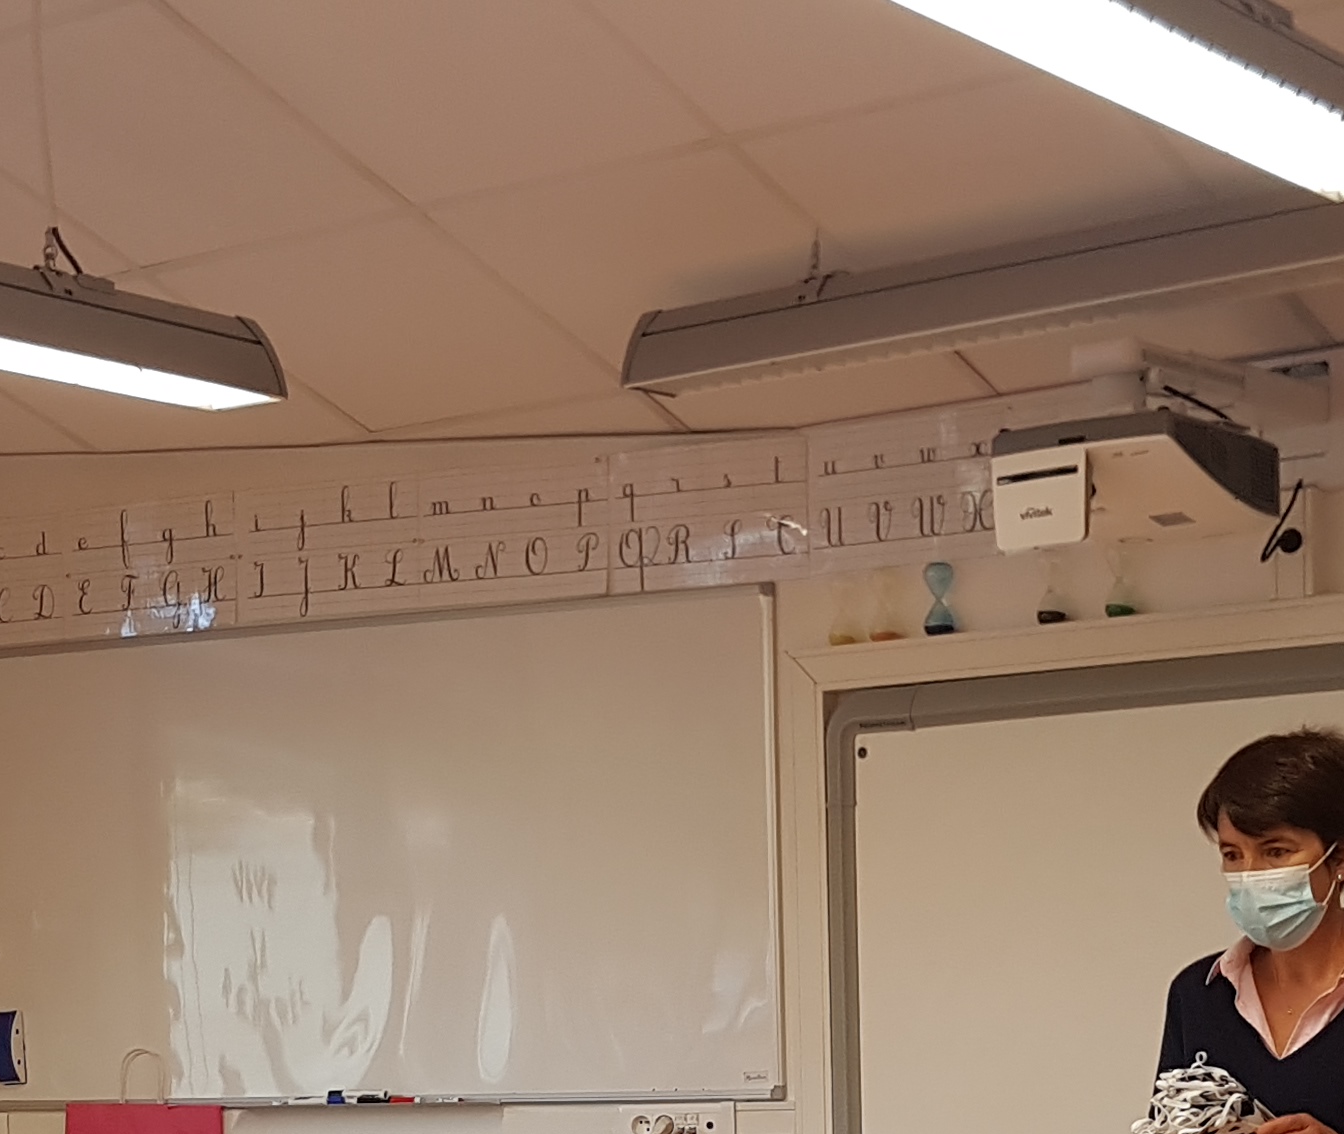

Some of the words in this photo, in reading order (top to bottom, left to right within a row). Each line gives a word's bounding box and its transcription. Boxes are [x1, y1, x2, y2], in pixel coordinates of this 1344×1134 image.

[32, 584, 55, 621] D
[78, 578, 92, 615] E
[121, 574, 139, 611] F
[162, 570, 187, 629] G
[201, 565, 227, 603] H
[253, 561, 265, 599] I
[297, 556, 311, 617] J
[337, 552, 362, 591] K
[384, 548, 406, 587] L
[423, 545, 460, 584] M
[475, 541, 506, 580] N
[525, 536, 548, 576] O
[577, 532, 600, 572] P
[619, 525, 661, 591] Q
[666, 523, 692, 565] R
[723, 518, 743, 560] S
[765, 514, 797, 555] T
[820, 507, 845, 548] U
[869, 500, 893, 542] V
[911, 494, 946, 538] W
[960, 488, 995, 533] X
[36, 531, 47, 555] d
[78, 537, 89, 550] e
[120, 509, 130, 570] f
[162, 529, 174, 565] g
[205, 500, 217, 537] h
[254, 514, 261, 531] i
[297, 509, 305, 550] j
[341, 485, 355, 523] k
[389, 480, 399, 519] l
[432, 501, 452, 516] m
[481, 496, 496, 511] n
[529, 492, 541, 507] o
[577, 487, 590, 527] p
[622, 483, 634, 522] q
[671, 477, 682, 493] r
[723, 473, 732, 488] s
[774, 455, 781, 484] t
[823, 460, 839, 476] u
[873, 453, 886, 469] v
[919, 447, 937, 464] w
[968, 442, 989, 458] x
